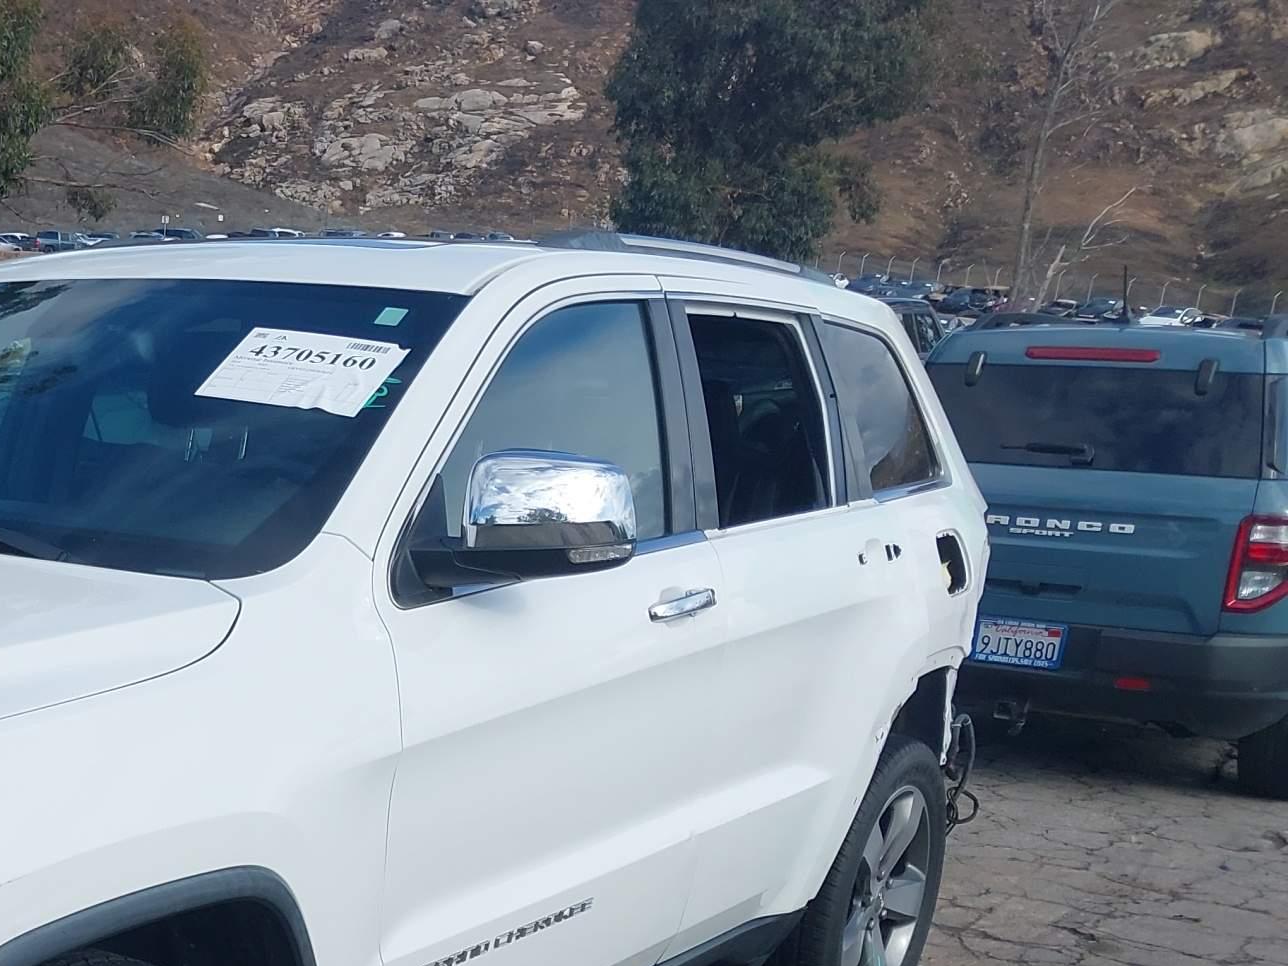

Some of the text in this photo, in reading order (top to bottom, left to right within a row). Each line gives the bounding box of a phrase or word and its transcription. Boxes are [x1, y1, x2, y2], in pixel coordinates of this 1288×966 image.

[249, 344, 376, 371] 43705160
[987, 514, 1136, 534] RONCO
[1008, 527, 1074, 537] SPORT
[493, 896, 594, 949] CHEROKEE
